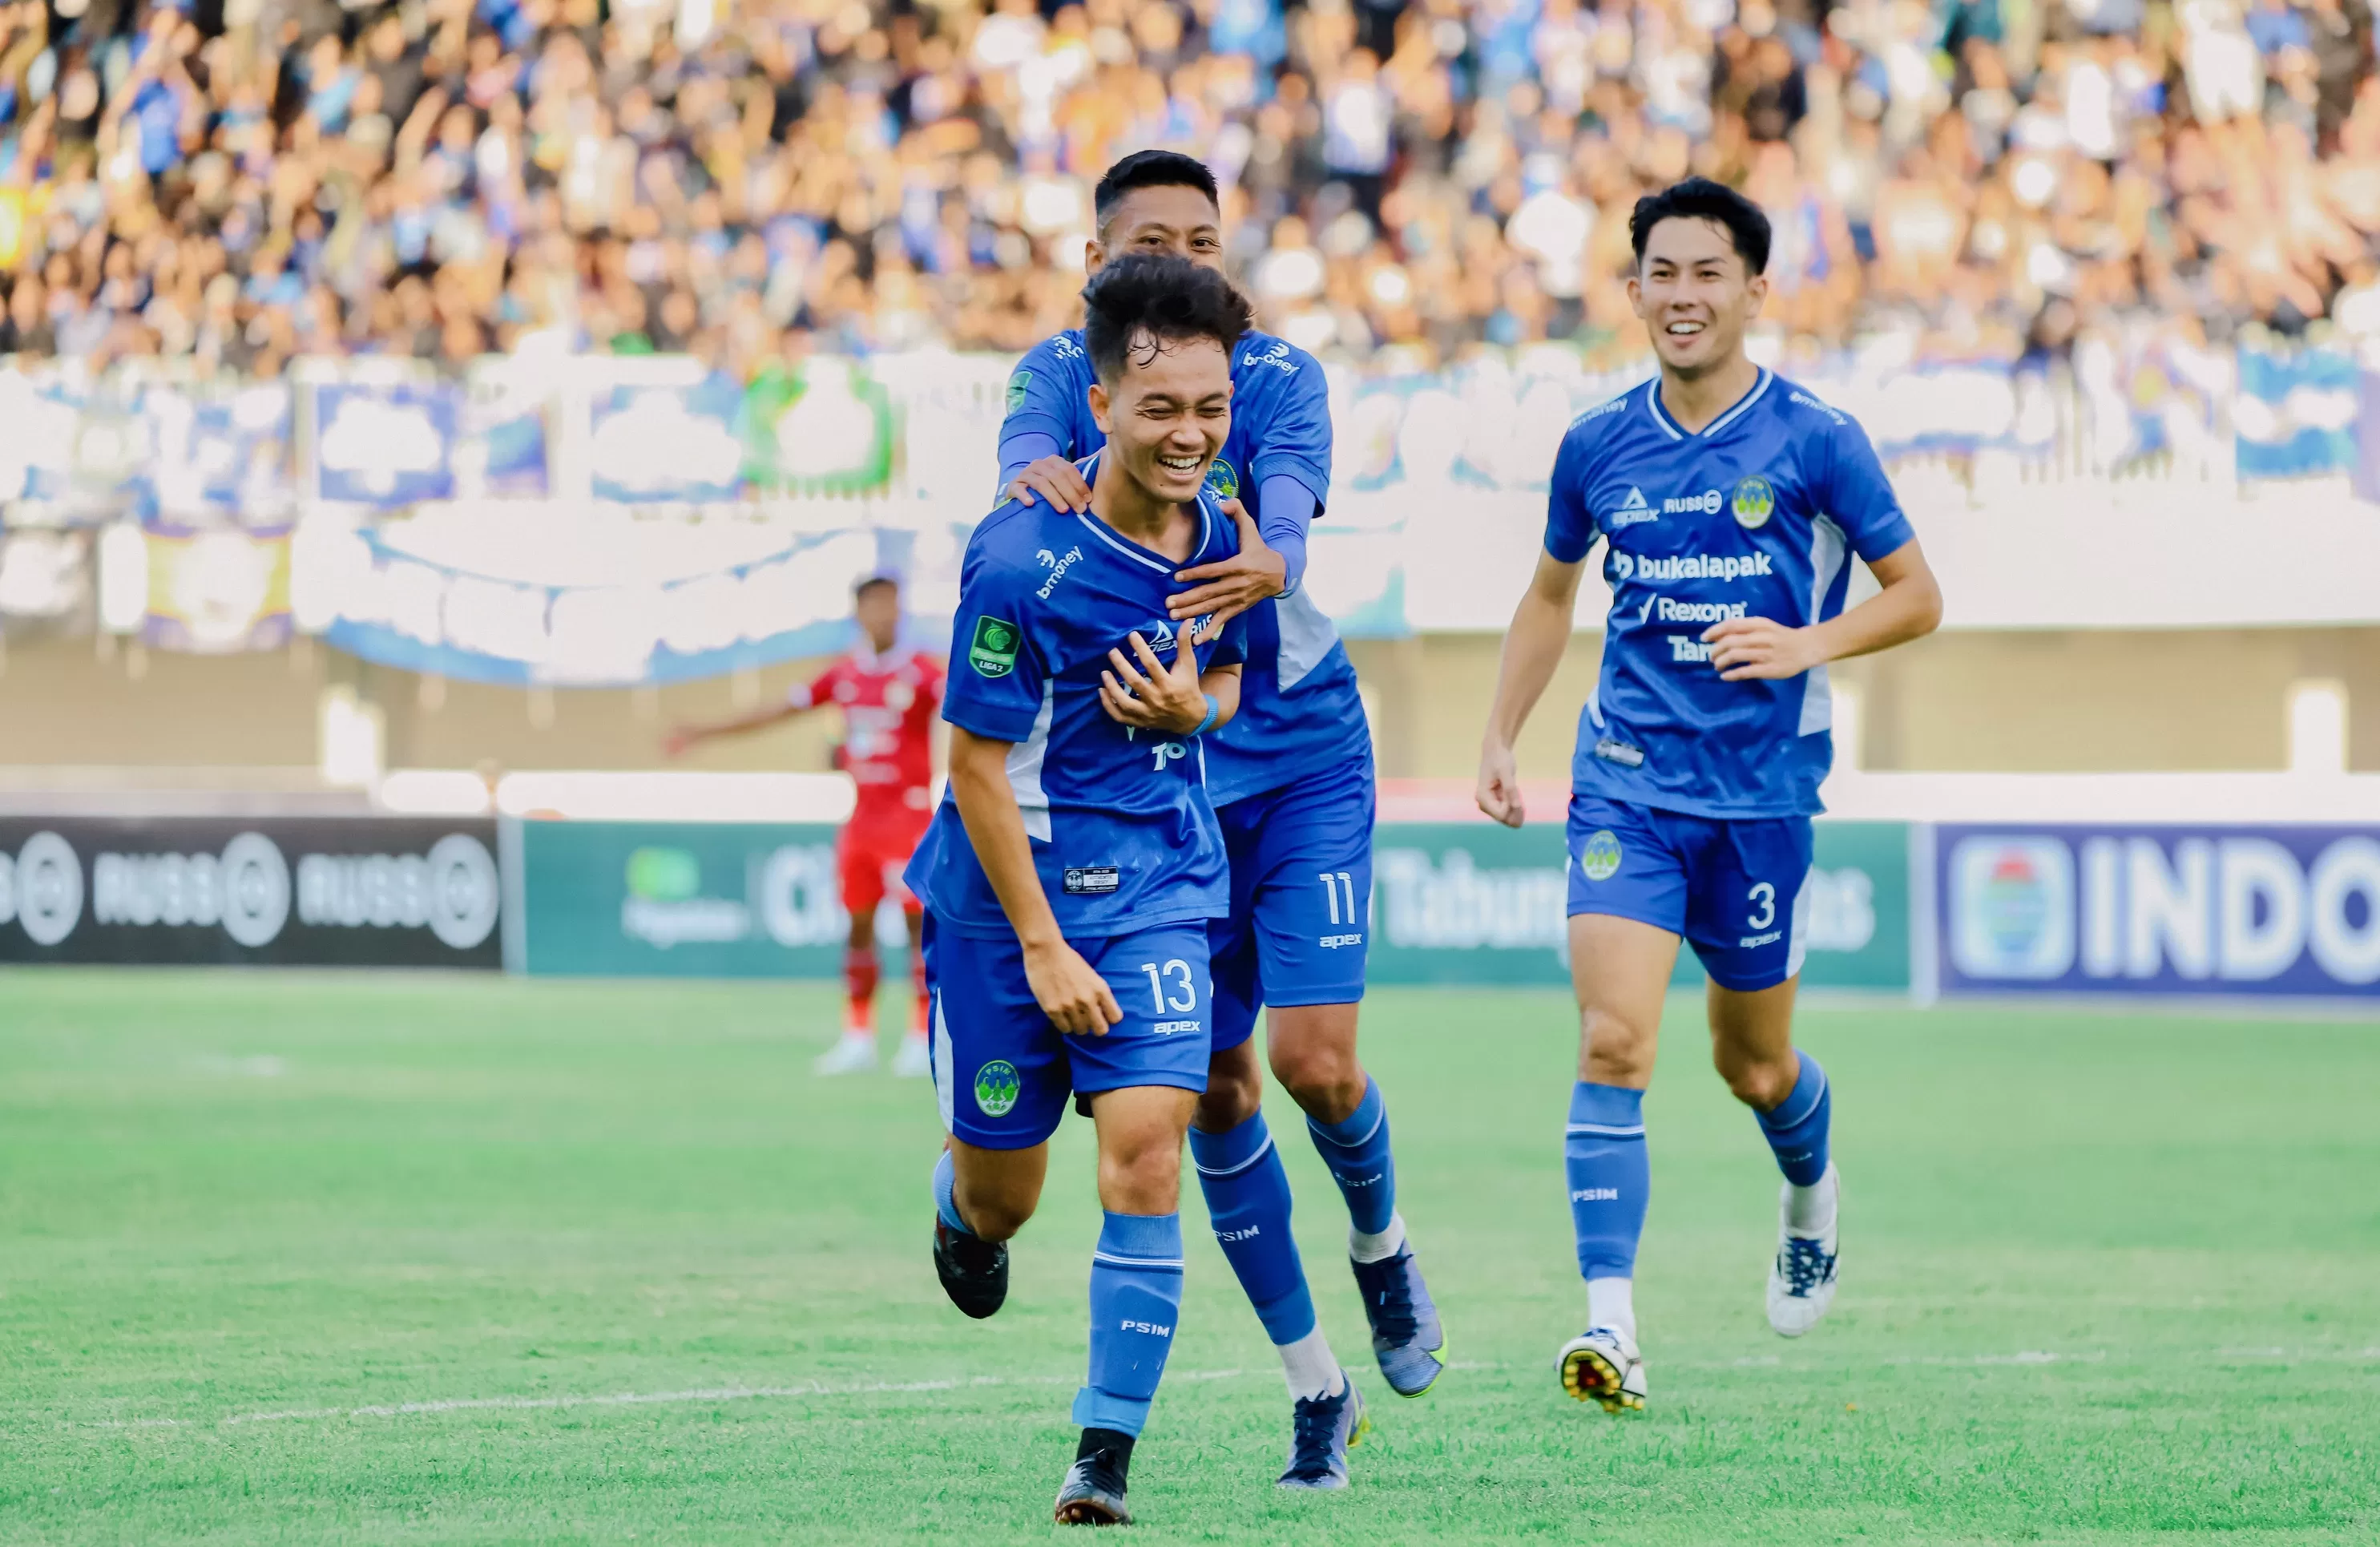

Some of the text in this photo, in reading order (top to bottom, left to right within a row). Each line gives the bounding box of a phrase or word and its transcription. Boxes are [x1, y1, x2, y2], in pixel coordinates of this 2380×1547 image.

[1036, 546, 1084, 600] bmoney
[1637, 551, 1773, 583] bukalapak
[1658, 597, 1746, 622] Rexona
[978, 660, 998, 671] LIGA
[1318, 871, 1356, 925] 11
[1748, 882, 1775, 930] 3
[2081, 834, 2380, 985] INDO
[1319, 933, 1362, 950] apex
[1739, 930, 1782, 949] apex
[1141, 958, 1197, 1015] 13
[1154, 1020, 1200, 1036] apex
[985, 1065, 1011, 1076] PSIM
[1572, 1188, 1619, 1203] PSIM
[1121, 1319, 1170, 1338] PSIM
